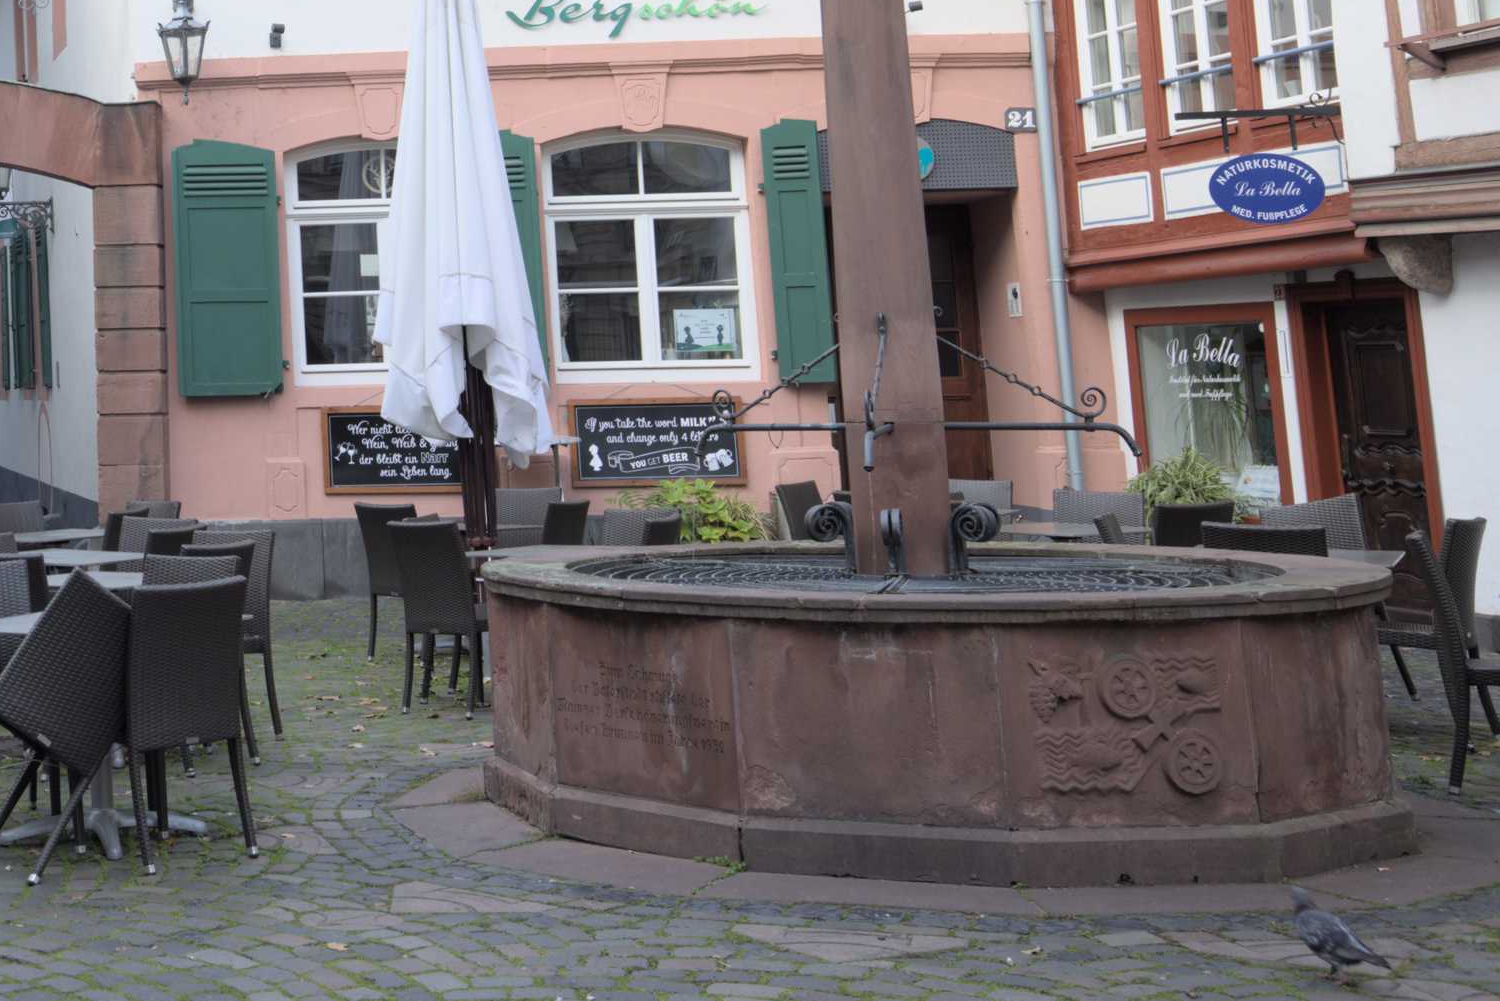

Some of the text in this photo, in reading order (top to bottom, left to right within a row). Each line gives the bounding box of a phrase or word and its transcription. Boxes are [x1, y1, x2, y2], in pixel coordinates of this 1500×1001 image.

[1008, 110, 1036, 128] 21
[1216, 158, 1316, 186] NATURKOSMETIK
[1235, 181, 1255, 197] La
[1231, 204, 1255, 219] MED.
[1166, 333, 1241, 368] La Bella
[347, 420, 369, 434] Wer
[370, 424, 392, 434] nicht
[585, 417, 597, 432] If
[599, 420, 615, 432] you
[615, 417, 636, 429] take
[636, 417, 653, 428] the
[654, 417, 678, 428] word
[362, 434, 389, 449] Wein,
[391, 433, 416, 448] Weib
[419, 438, 427, 448] &
[606, 432, 624, 443] and
[626, 432, 657, 446] change
[659, 431, 678, 446] only
[682, 432, 688, 441] 4
[359, 453, 373, 464] der
[376, 452, 402, 464] bleibt
[404, 453, 418, 463] ein
[630, 452, 689, 469] YOU GET BEER
[380, 465, 452, 480] sein Leben lang.
